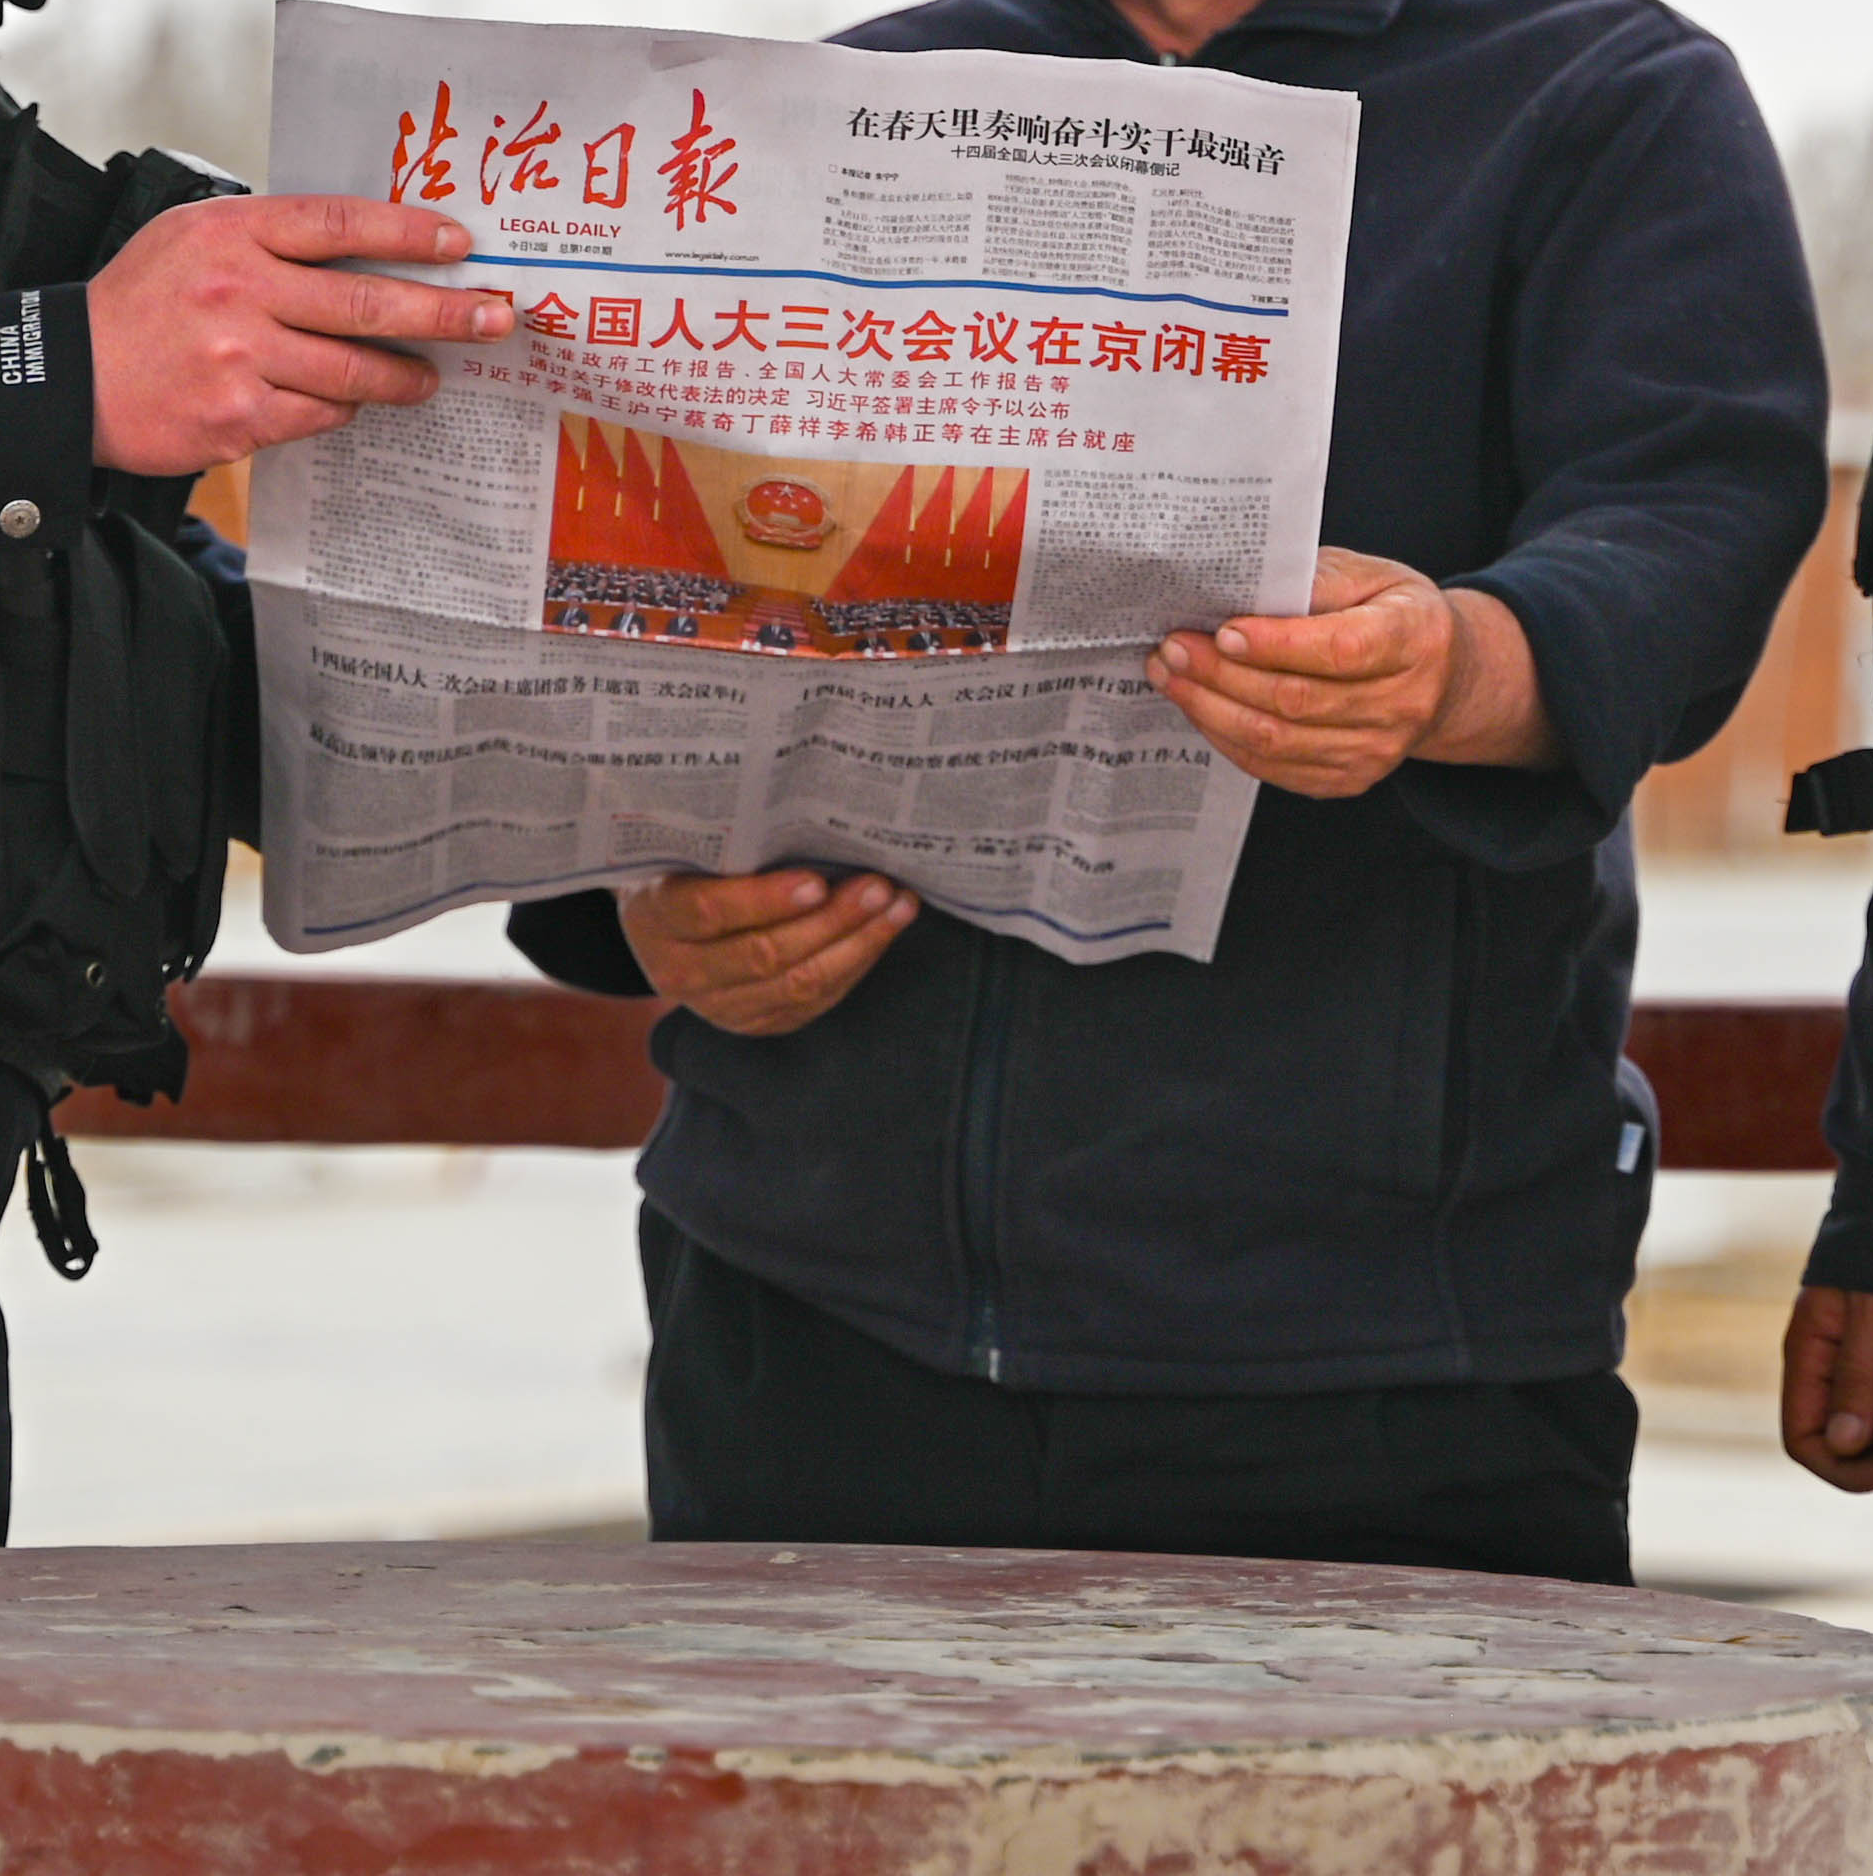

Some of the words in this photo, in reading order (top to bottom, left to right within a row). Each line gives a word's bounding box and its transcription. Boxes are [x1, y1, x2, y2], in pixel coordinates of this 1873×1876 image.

[846, 106, 1286, 175] 在春天里奏响奋斗实干最强音
[951, 144, 1180, 177] 十四届全国人大三次会议闭幕侧记
[500, 218, 560, 235] LEGAL
[567, 221, 621, 238] DAILY
[0, 325, 22, 384] CHINA
[466, 288, 1271, 384] 全国人大三次会议在京闭幕
[531, 339, 1072, 393] 批准政府工作报告、全国人大常委会工作报告等
[463, 359, 1136, 453] 习近平李强王沪宁蔡奇丁薛祥李希韩正等在主席台就座
[529, 354, 790, 407] 通过关于修改代表法的决定
[806, 388, 1071, 419] 习近平签署主席令予以公布
